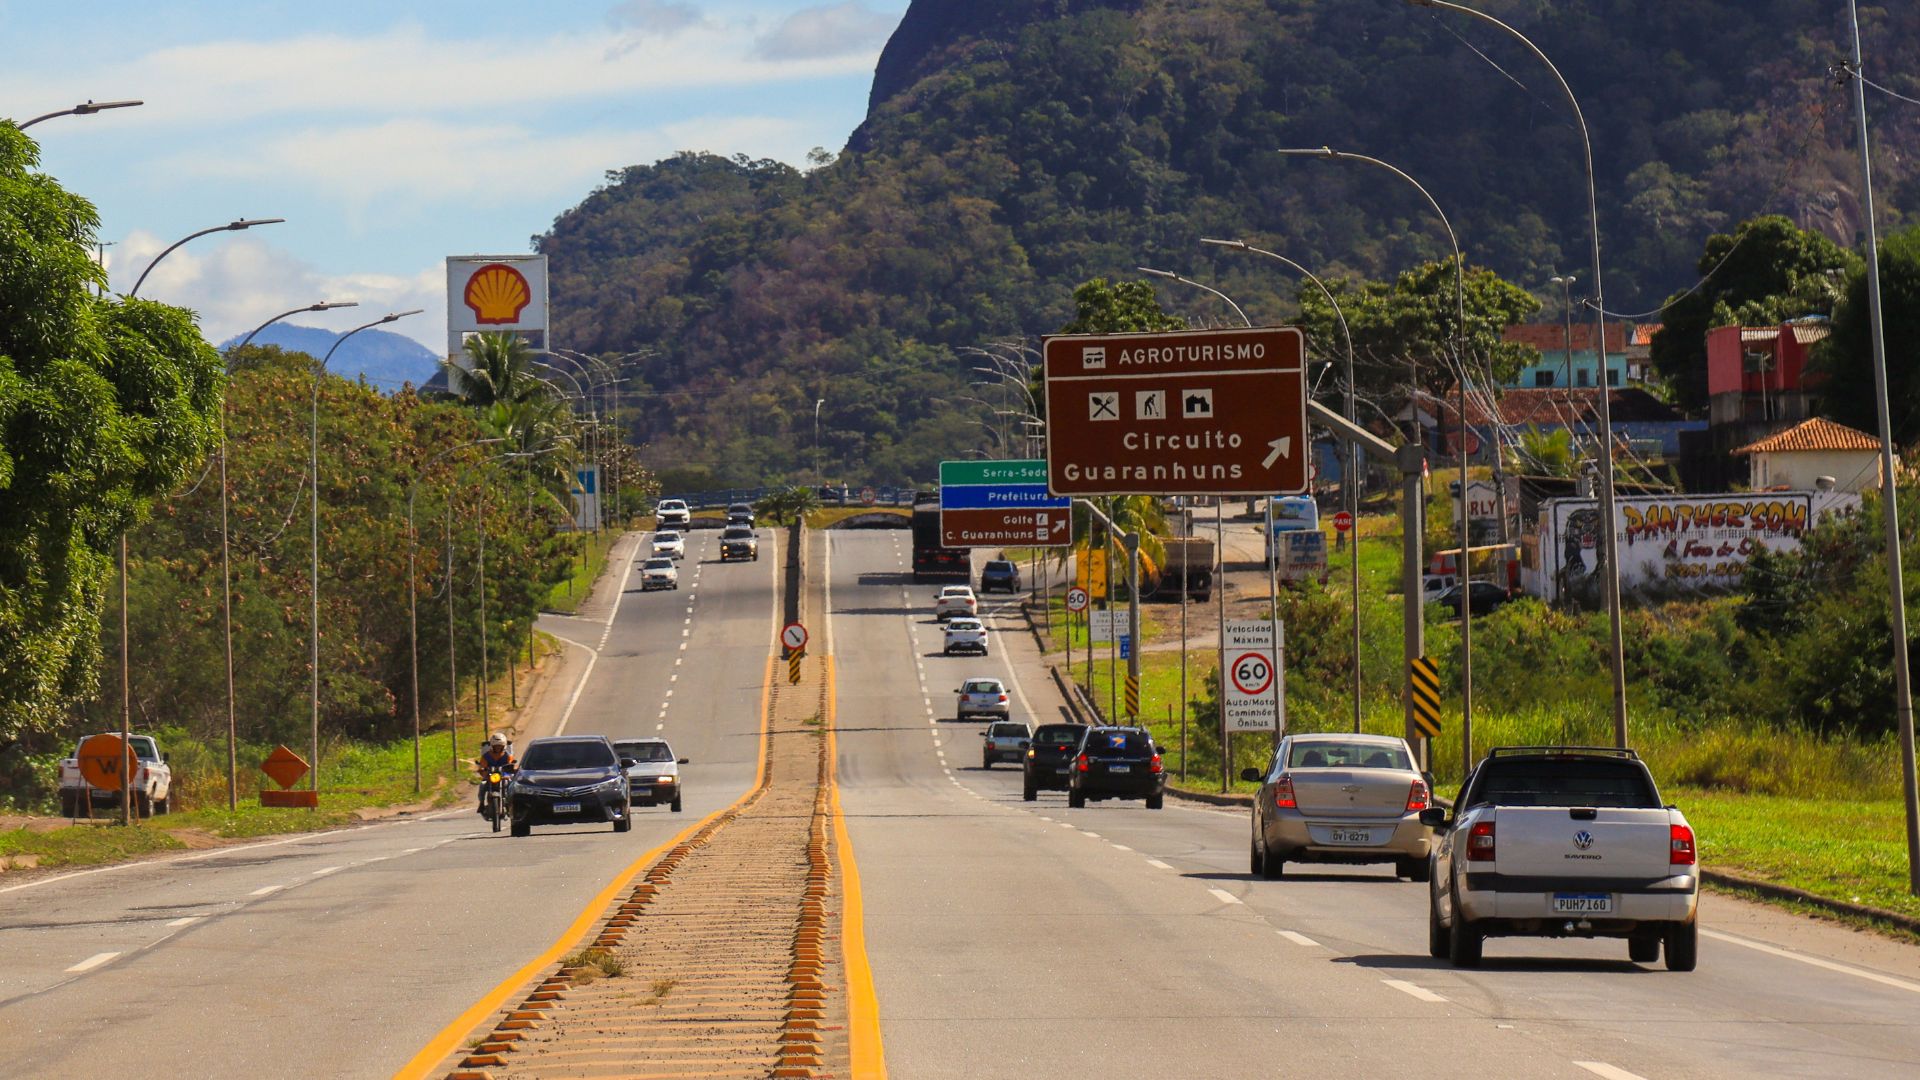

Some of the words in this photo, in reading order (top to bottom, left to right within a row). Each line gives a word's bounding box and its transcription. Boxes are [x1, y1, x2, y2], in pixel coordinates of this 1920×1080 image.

[1119, 343, 1265, 365] AGROTURISMO
[1123, 430, 1242, 450] Circuito
[983, 468, 1047, 478] Serra-Sede
[1064, 462, 1242, 481] Guaranhuns
[988, 492, 1048, 501] Prefeitura
[1470, 500, 1496, 516] RLY
[946, 531, 956, 540] C.
[961, 530, 1034, 540] Guaranhuns
[1069, 593, 1085, 604] 60
[1226, 625, 1271, 633] Velocidad
[1238, 663, 1266, 680] 60
[1237, 718, 1269, 727] Ônibus
[1559, 899, 1606, 910] PUH7160
